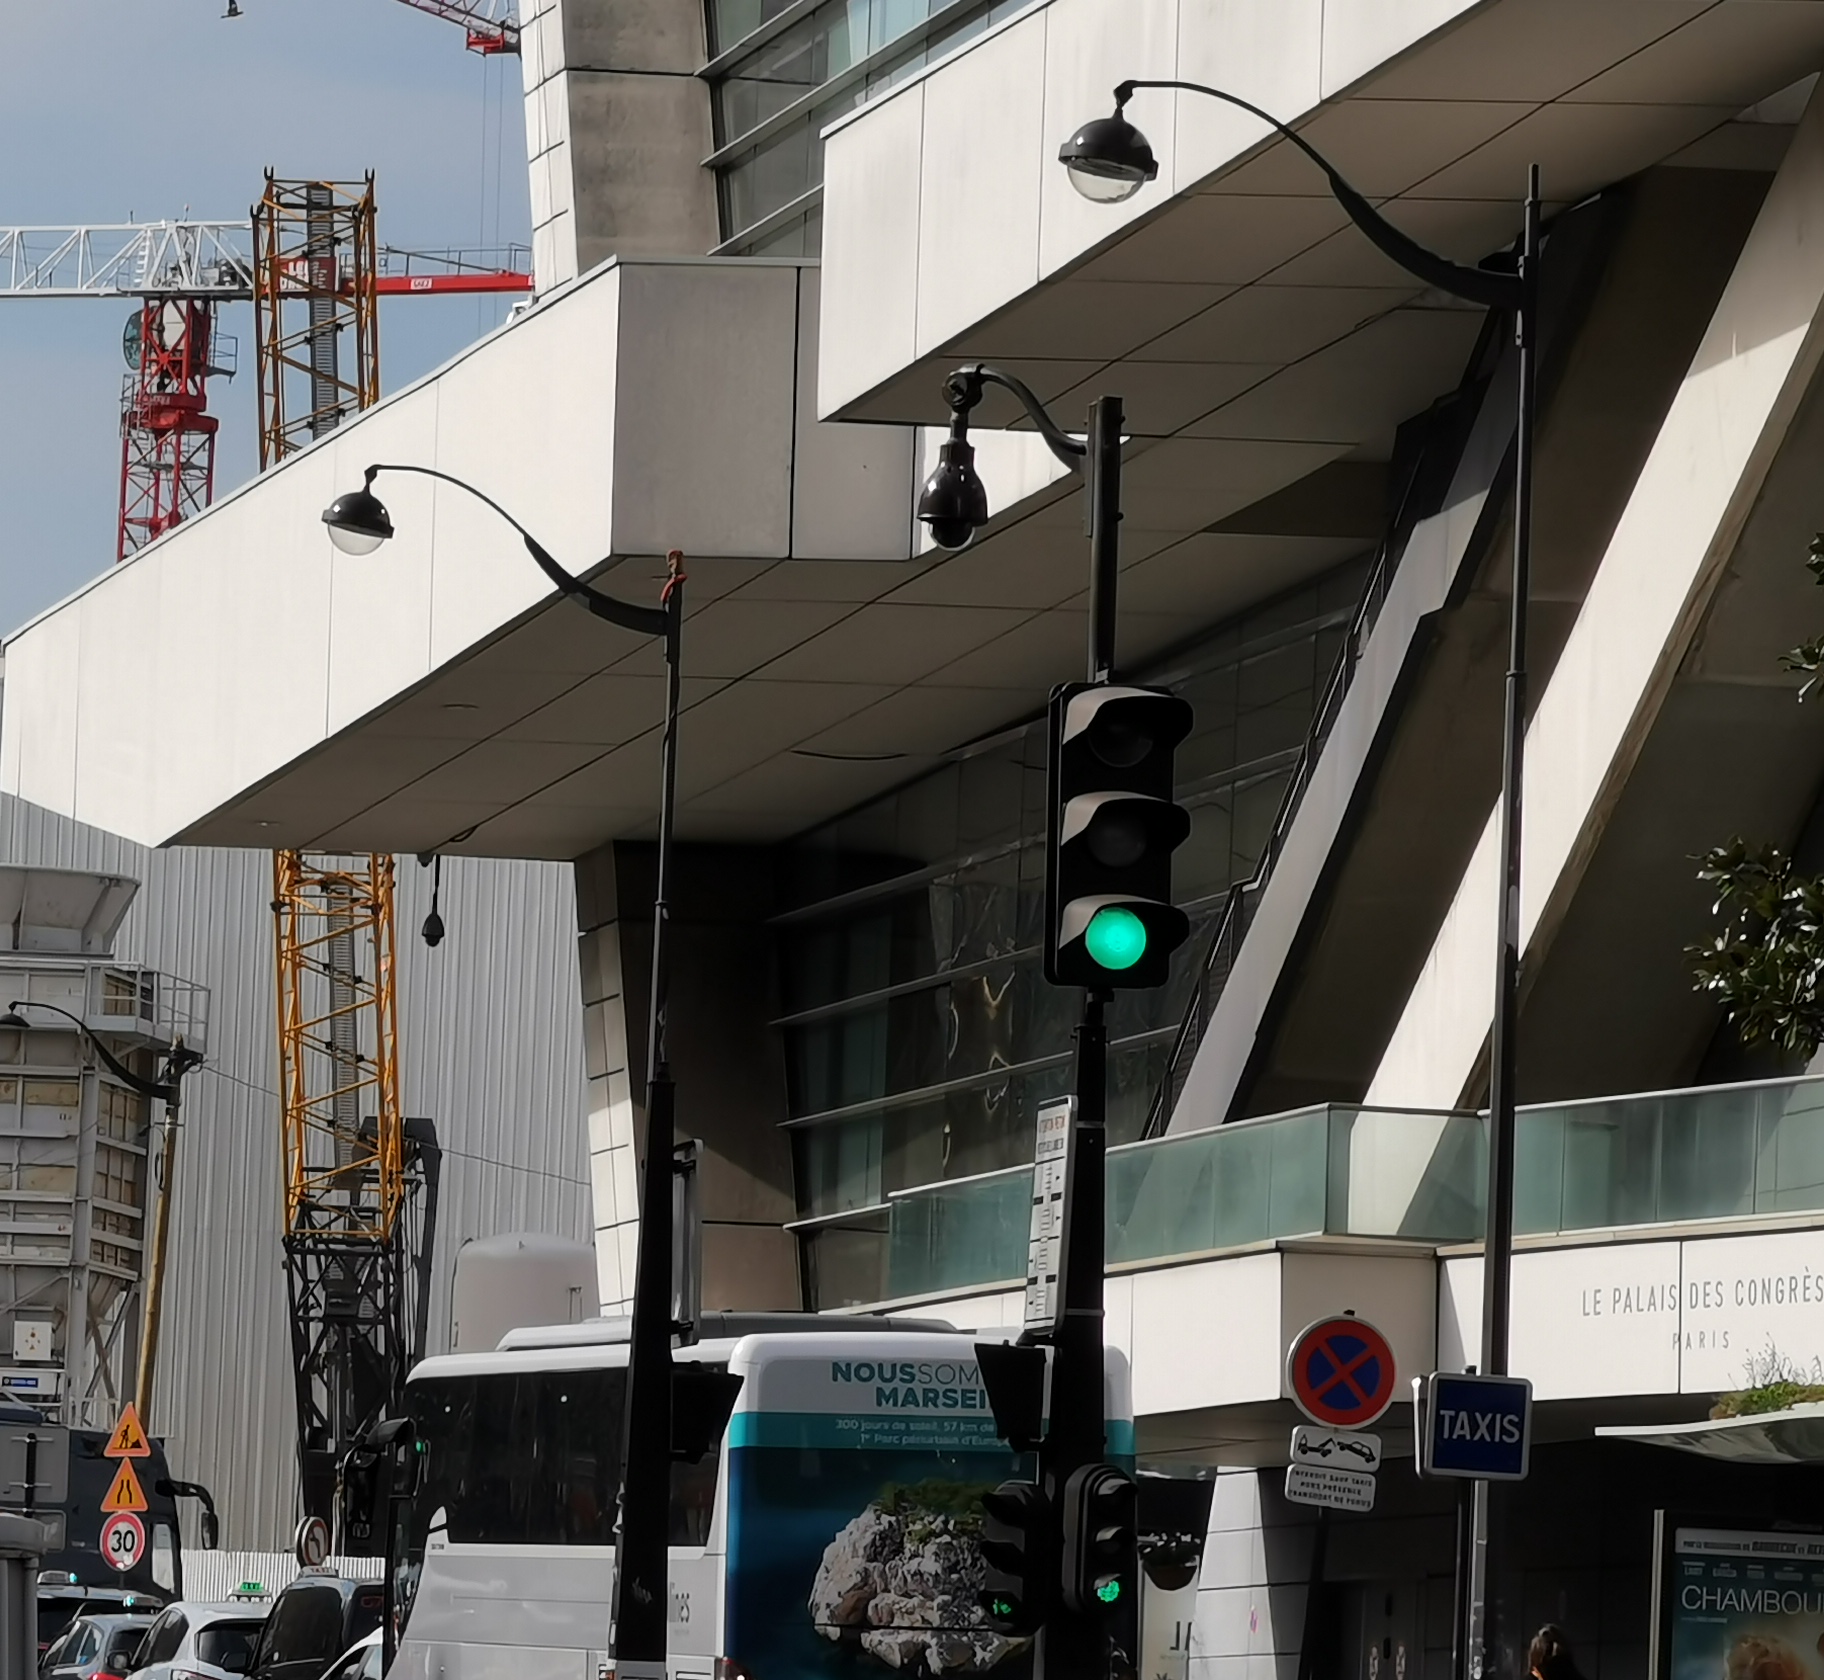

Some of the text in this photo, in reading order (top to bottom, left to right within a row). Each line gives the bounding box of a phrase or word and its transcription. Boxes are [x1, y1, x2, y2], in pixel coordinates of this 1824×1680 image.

[1582, 1265, 1824, 1316] LE PALAIS DES CONGRÈS
[1672, 1330, 1730, 1350] PARIS
[831, 1361, 980, 1386] NOUSSOM
[875, 1386, 988, 1410] MARSEI
[1439, 1409, 1520, 1444] TAXIS
[111, 1529, 136, 1553] 30
[1681, 1585, 1824, 1615] CHAMBOU
